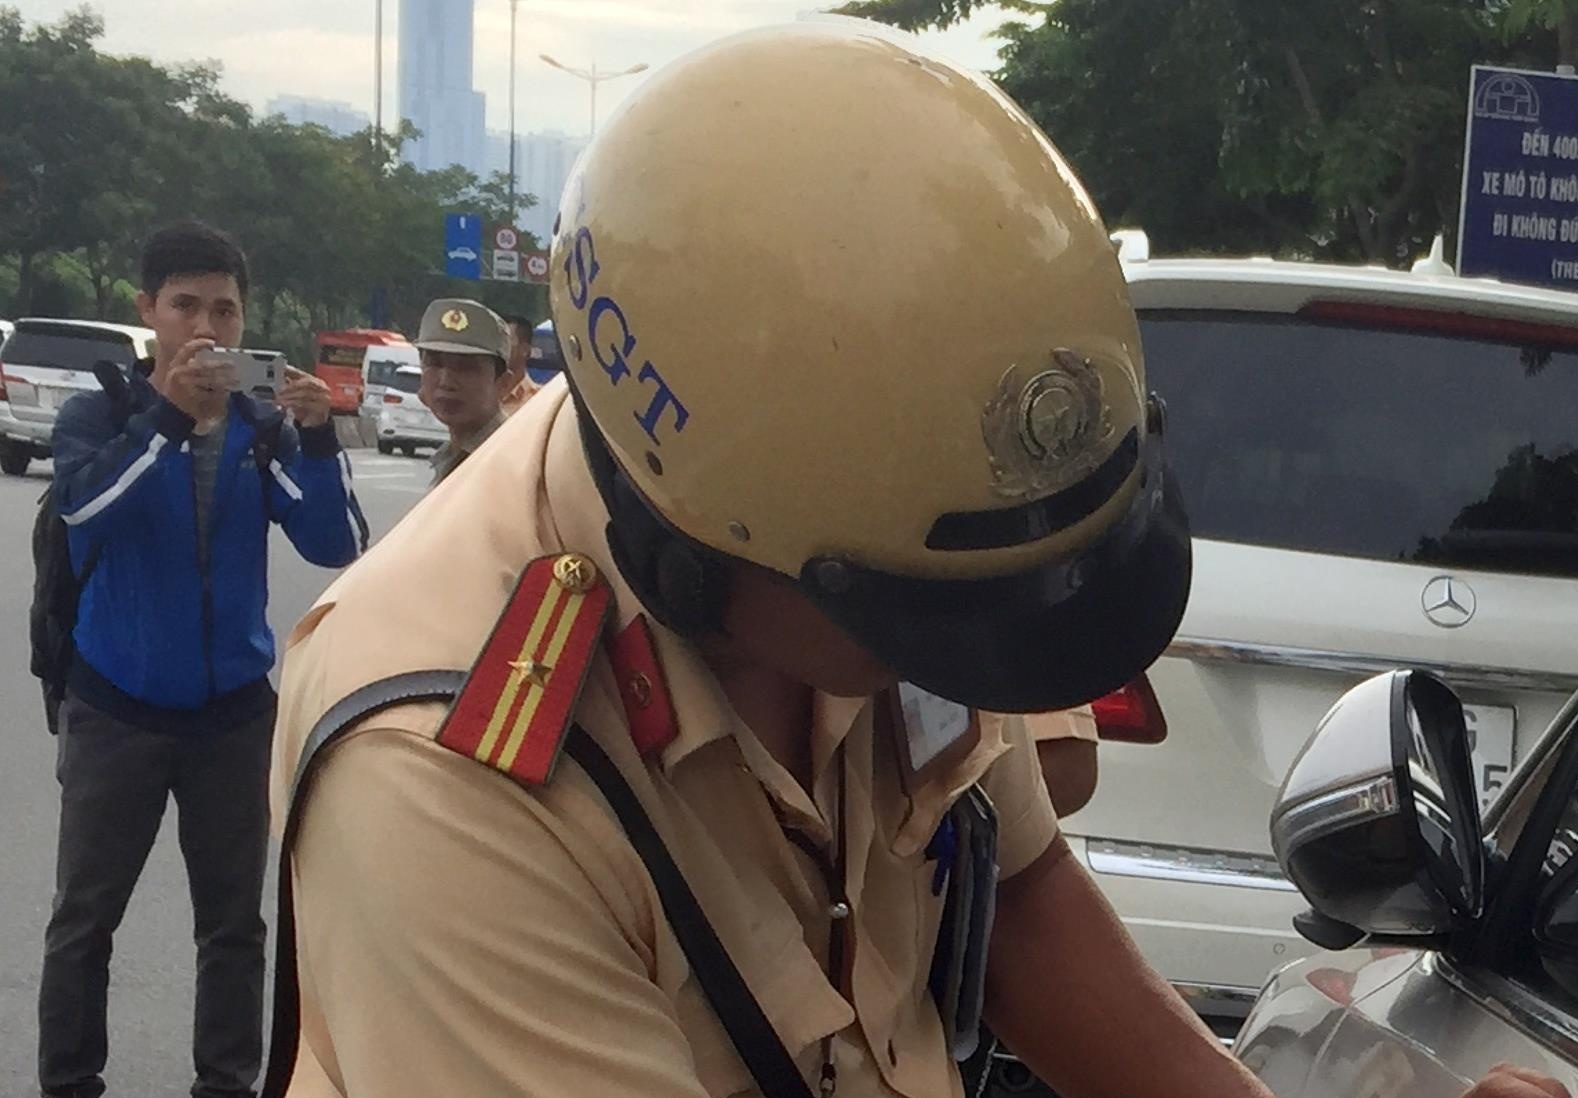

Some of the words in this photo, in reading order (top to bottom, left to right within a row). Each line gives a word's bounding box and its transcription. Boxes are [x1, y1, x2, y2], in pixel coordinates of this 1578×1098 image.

[1521, 127, 1550, 157] ĐẾN
[1481, 171, 1500, 195] XE
[1503, 170, 1526, 198] MÔ
[1529, 171, 1547, 199] TÔ
[1493, 213, 1508, 236] ĐI
[1511, 211, 1557, 241] KHÔNG
[562, 200, 690, 446] SGT
